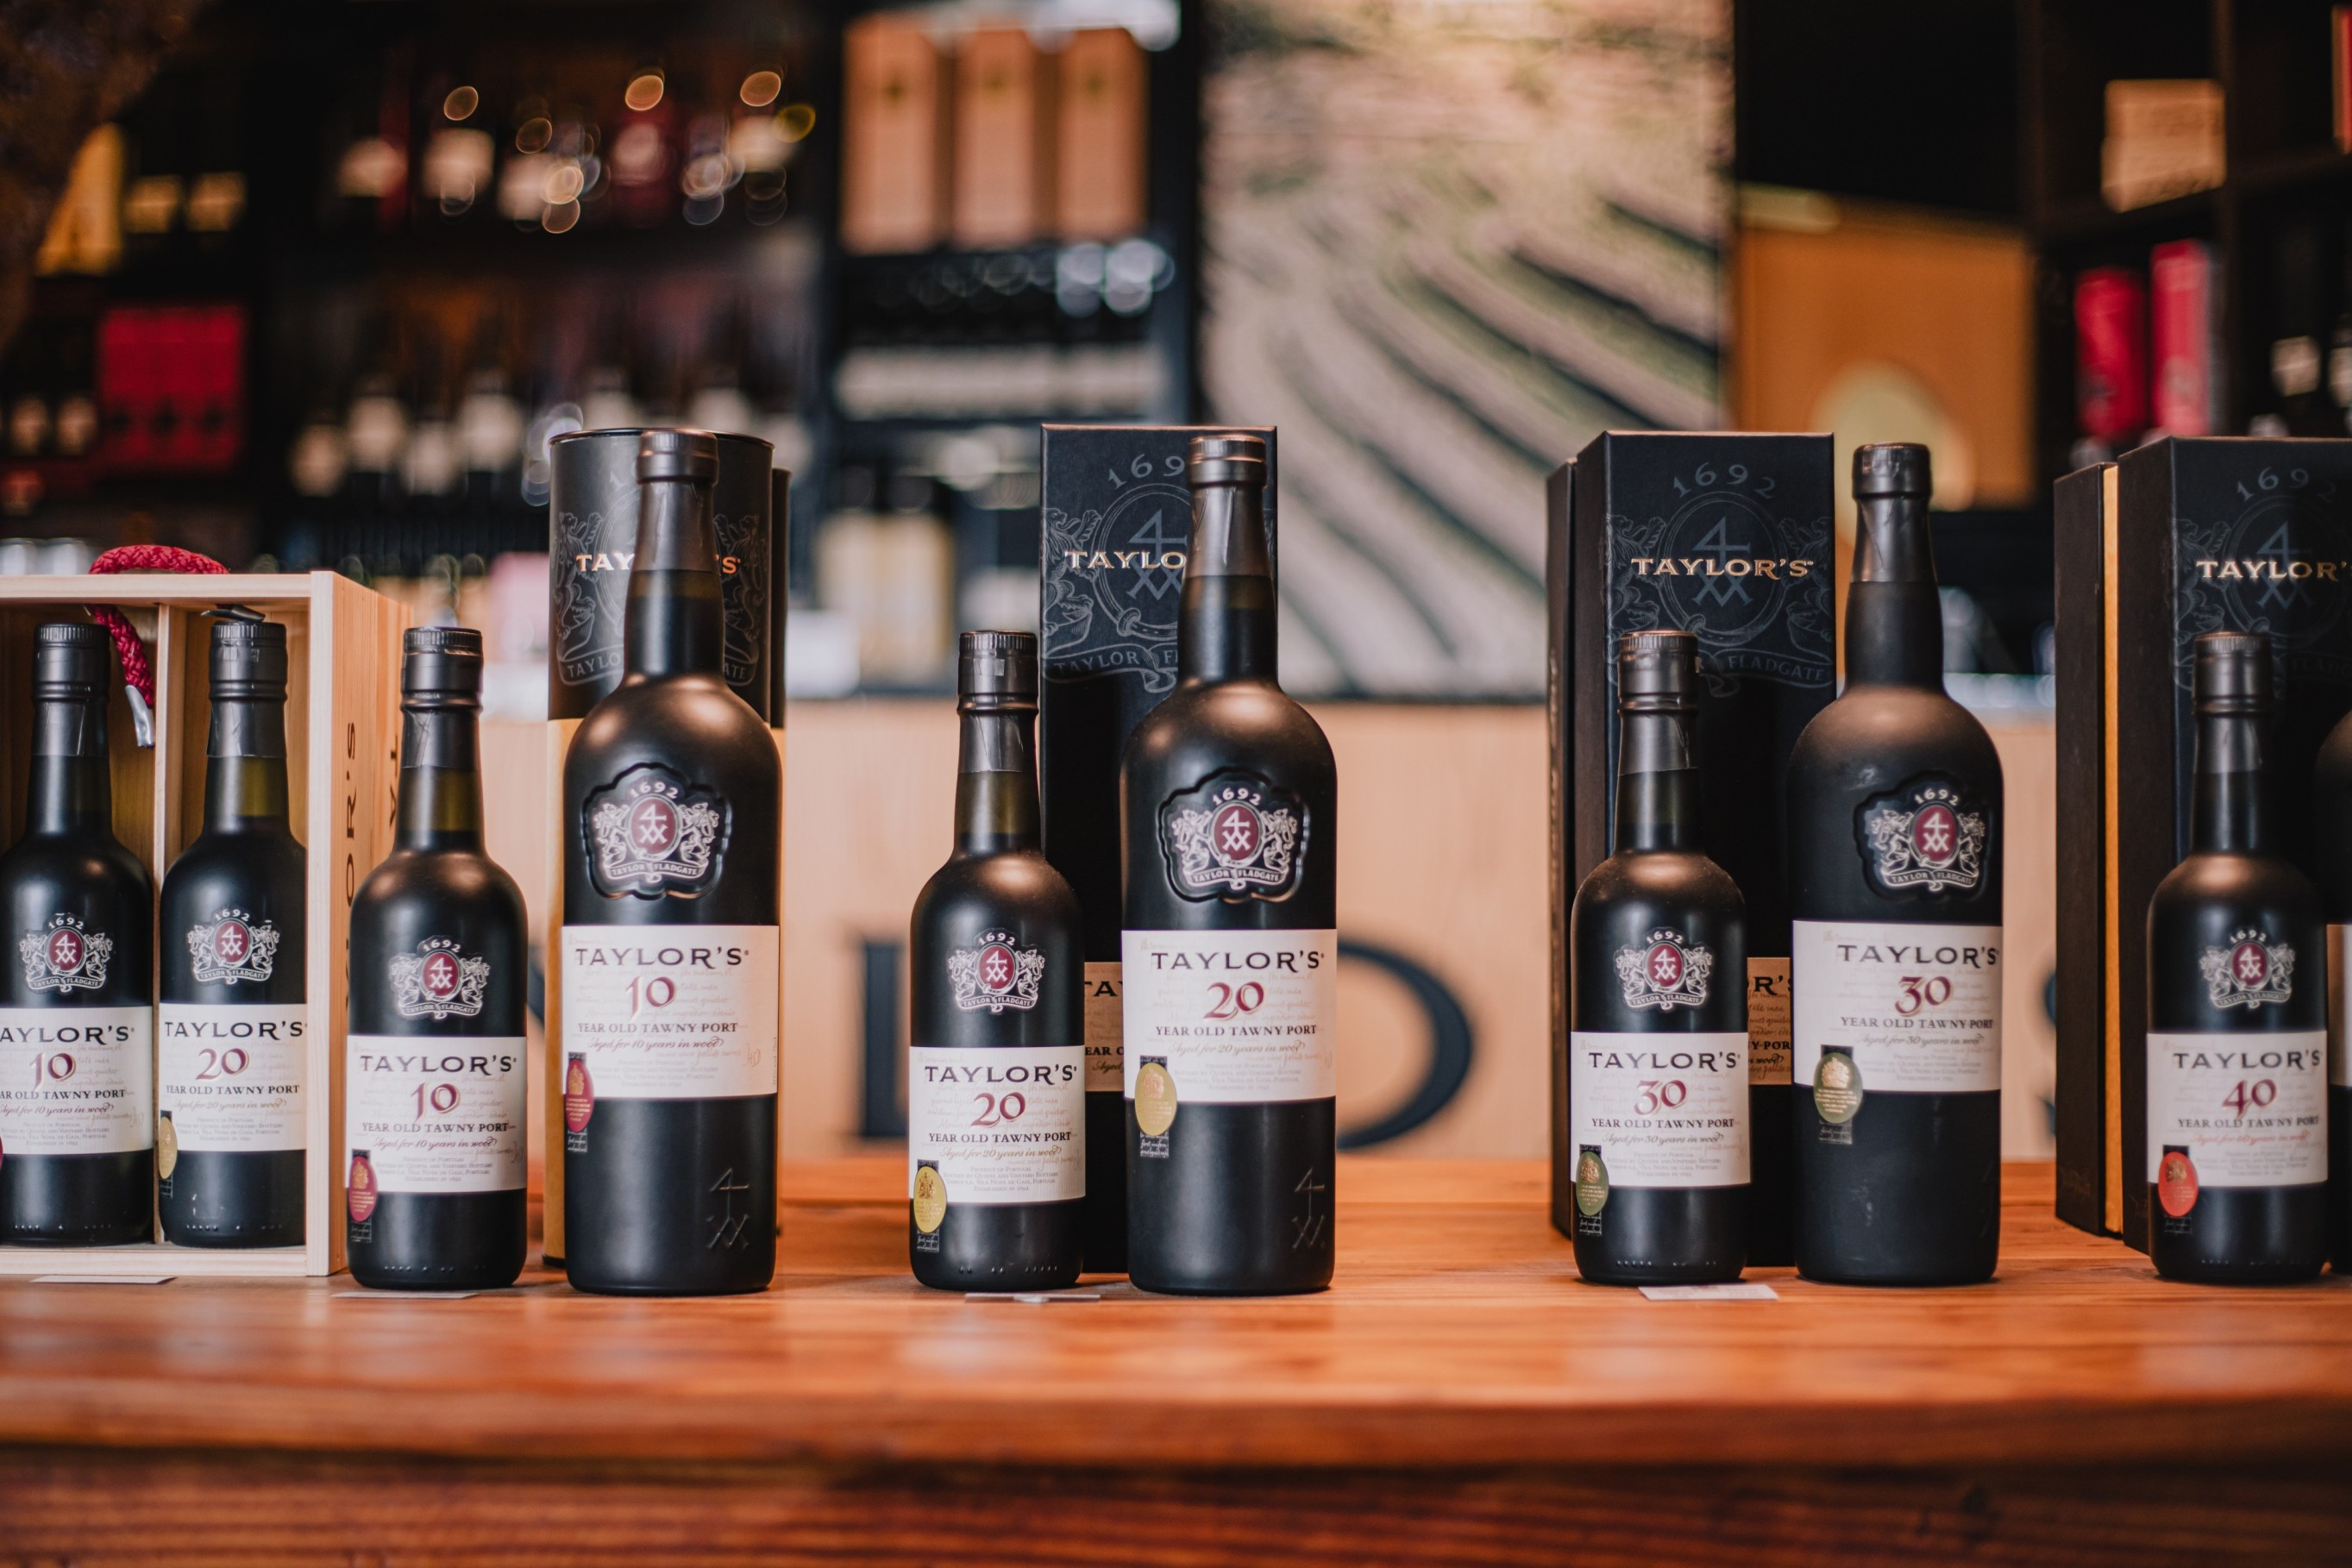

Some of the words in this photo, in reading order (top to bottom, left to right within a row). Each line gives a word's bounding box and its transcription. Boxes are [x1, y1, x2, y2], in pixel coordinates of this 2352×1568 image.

[1108, 454, 1185, 489] 169
[1673, 462, 1776, 499] 1692
[576, 553, 737, 574] TAY'S
[1064, 551, 1187, 569] TAYLO
[1631, 558, 1808, 580] TAYLOR'S
[2196, 561, 2347, 582] TAYLOR'
[568, 652, 620, 678] TAYLO
[1053, 650, 1140, 674] TAYLOR
[1728, 655, 1825, 681] FLADGATE
[630, 782, 678, 799] 1692
[1213, 788, 1261, 806] 1692
[1915, 789, 1958, 806] 1692
[612, 864, 646, 875] TAYLOR
[655, 863, 698, 875] FLADGATE
[1194, 869, 1230, 881] TAYLOR
[1239, 869, 1279, 881] FLADGATE
[1891, 872, 1928, 883] TAYLOR
[48, 917, 84, 930] 1692
[215, 909, 250, 922] 1692
[423, 940, 461, 952] 1692
[979, 932, 1014, 945] 1692
[1646, 931, 1683, 944] 1692
[2230, 930, 2267, 944] 1692
[576, 946, 743, 969] TAYLOR'S
[1151, 950, 1320, 973] TAYLOR'S
[1837, 944, 1997, 969] TAYLOR'S
[34, 978, 60, 988] TAYLOR
[66, 978, 98, 987] FLADGATE
[625, 975, 677, 1021] 10
[963, 997, 990, 1007] TAYLOR
[998, 996, 1031, 1007] FLADGATE
[1203, 982, 1265, 1021] 20
[1895, 976, 1953, 1016] 30
[165, 1020, 303, 1041] TAYLOR'S
[578, 1023, 605, 1033] YEAR
[609, 1023, 637, 1033] OLD
[642, 1023, 697, 1033] TAWNY
[701, 1022, 738, 1033] PORT
[1156, 1026, 1189, 1036] YEAR
[1194, 1026, 1225, 1036] OLD
[1228, 1025, 1282, 1036] TAWNY
[1287, 1025, 1316, 1035] PORT
[1841, 1018, 1878, 1027] YEAR
[1883, 1019, 1914, 1028] OLD
[1918, 1019, 1966, 1028] TAWNY
[1970, 1019, 1994, 1029] PORT
[0, 1025, 129, 1045] AYLOR'S
[588, 1038, 613, 1052] Aged
[612, 1038, 630, 1051] for
[632, 1040, 644, 1049] 10
[645, 1040, 675, 1052] years
[678, 1038, 690, 1048] in
[692, 1036, 724, 1048] wood
[1085, 1046, 1111, 1057] EAR
[1170, 1043, 1198, 1056] Aged
[1198, 1043, 1217, 1056] for
[1233, 1044, 1263, 1057] years
[1265, 1043, 1277, 1051] in
[1279, 1039, 1305, 1051] wood
[1764, 1041, 1791, 1051] POR
[195, 1048, 250, 1080] 20
[361, 1055, 512, 1076] TAYLOR'S
[1589, 1051, 1736, 1072] TAYLOR'S
[2173, 1050, 2320, 1070] TAYLOR'S
[29, 1052, 76, 1090] 10
[925, 1064, 1072, 1085] TAYLOR'S
[16, 1090, 39, 1100] OLD
[44, 1090, 91, 1100] TAWNY
[95, 1088, 126, 1099] PORT
[166, 1085, 186, 1094] YEAR
[190, 1086, 213, 1094] OLD
[216, 1086, 264, 1094] TAWNY
[268, 1085, 300, 1094] PORT
[1634, 1079, 1687, 1115] 30
[411, 1082, 461, 1123] 10
[2221, 1079, 2277, 1120] 40
[0, 1104, 20, 1117] Aged
[19, 1106, 33, 1117] for
[35, 1106, 46, 1114] 10
[47, 1107, 72, 1117] years
[970, 1092, 1026, 1127] 20
[362, 1123, 389, 1132] YEAR
[393, 1123, 420, 1132] OLD
[423, 1123, 475, 1133] TAWNY
[479, 1123, 509, 1132] PORT
[1592, 1119, 1621, 1128] YEAR
[1625, 1120, 1652, 1128] OLD
[1656, 1120, 1703, 1128] TAWNY
[1708, 1119, 1734, 1128] PORT
[2179, 1119, 2210, 1128] YEAR
[2215, 1120, 2243, 1128] OLD
[2248, 1120, 2293, 1128] TAWNY
[2298, 1116, 2319, 1126] PORT
[373, 1138, 396, 1151] Aged
[396, 1138, 414, 1151] for
[417, 1139, 429, 1148] 10
[429, 1140, 456, 1152] years
[458, 1138, 468, 1147] in
[471, 1136, 498, 1147] wood
[929, 1133, 957, 1143] YEAR
[961, 1134, 988, 1143] OLD
[992, 1133, 1040, 1143] TAWNY
[1044, 1132, 1072, 1142] PORT
[940, 1147, 964, 1161] Aged
[965, 1148, 982, 1160] for
[996, 1150, 1023, 1160] years
[1025, 1148, 1036, 1157] in
[1038, 1145, 1062, 1157] wood
